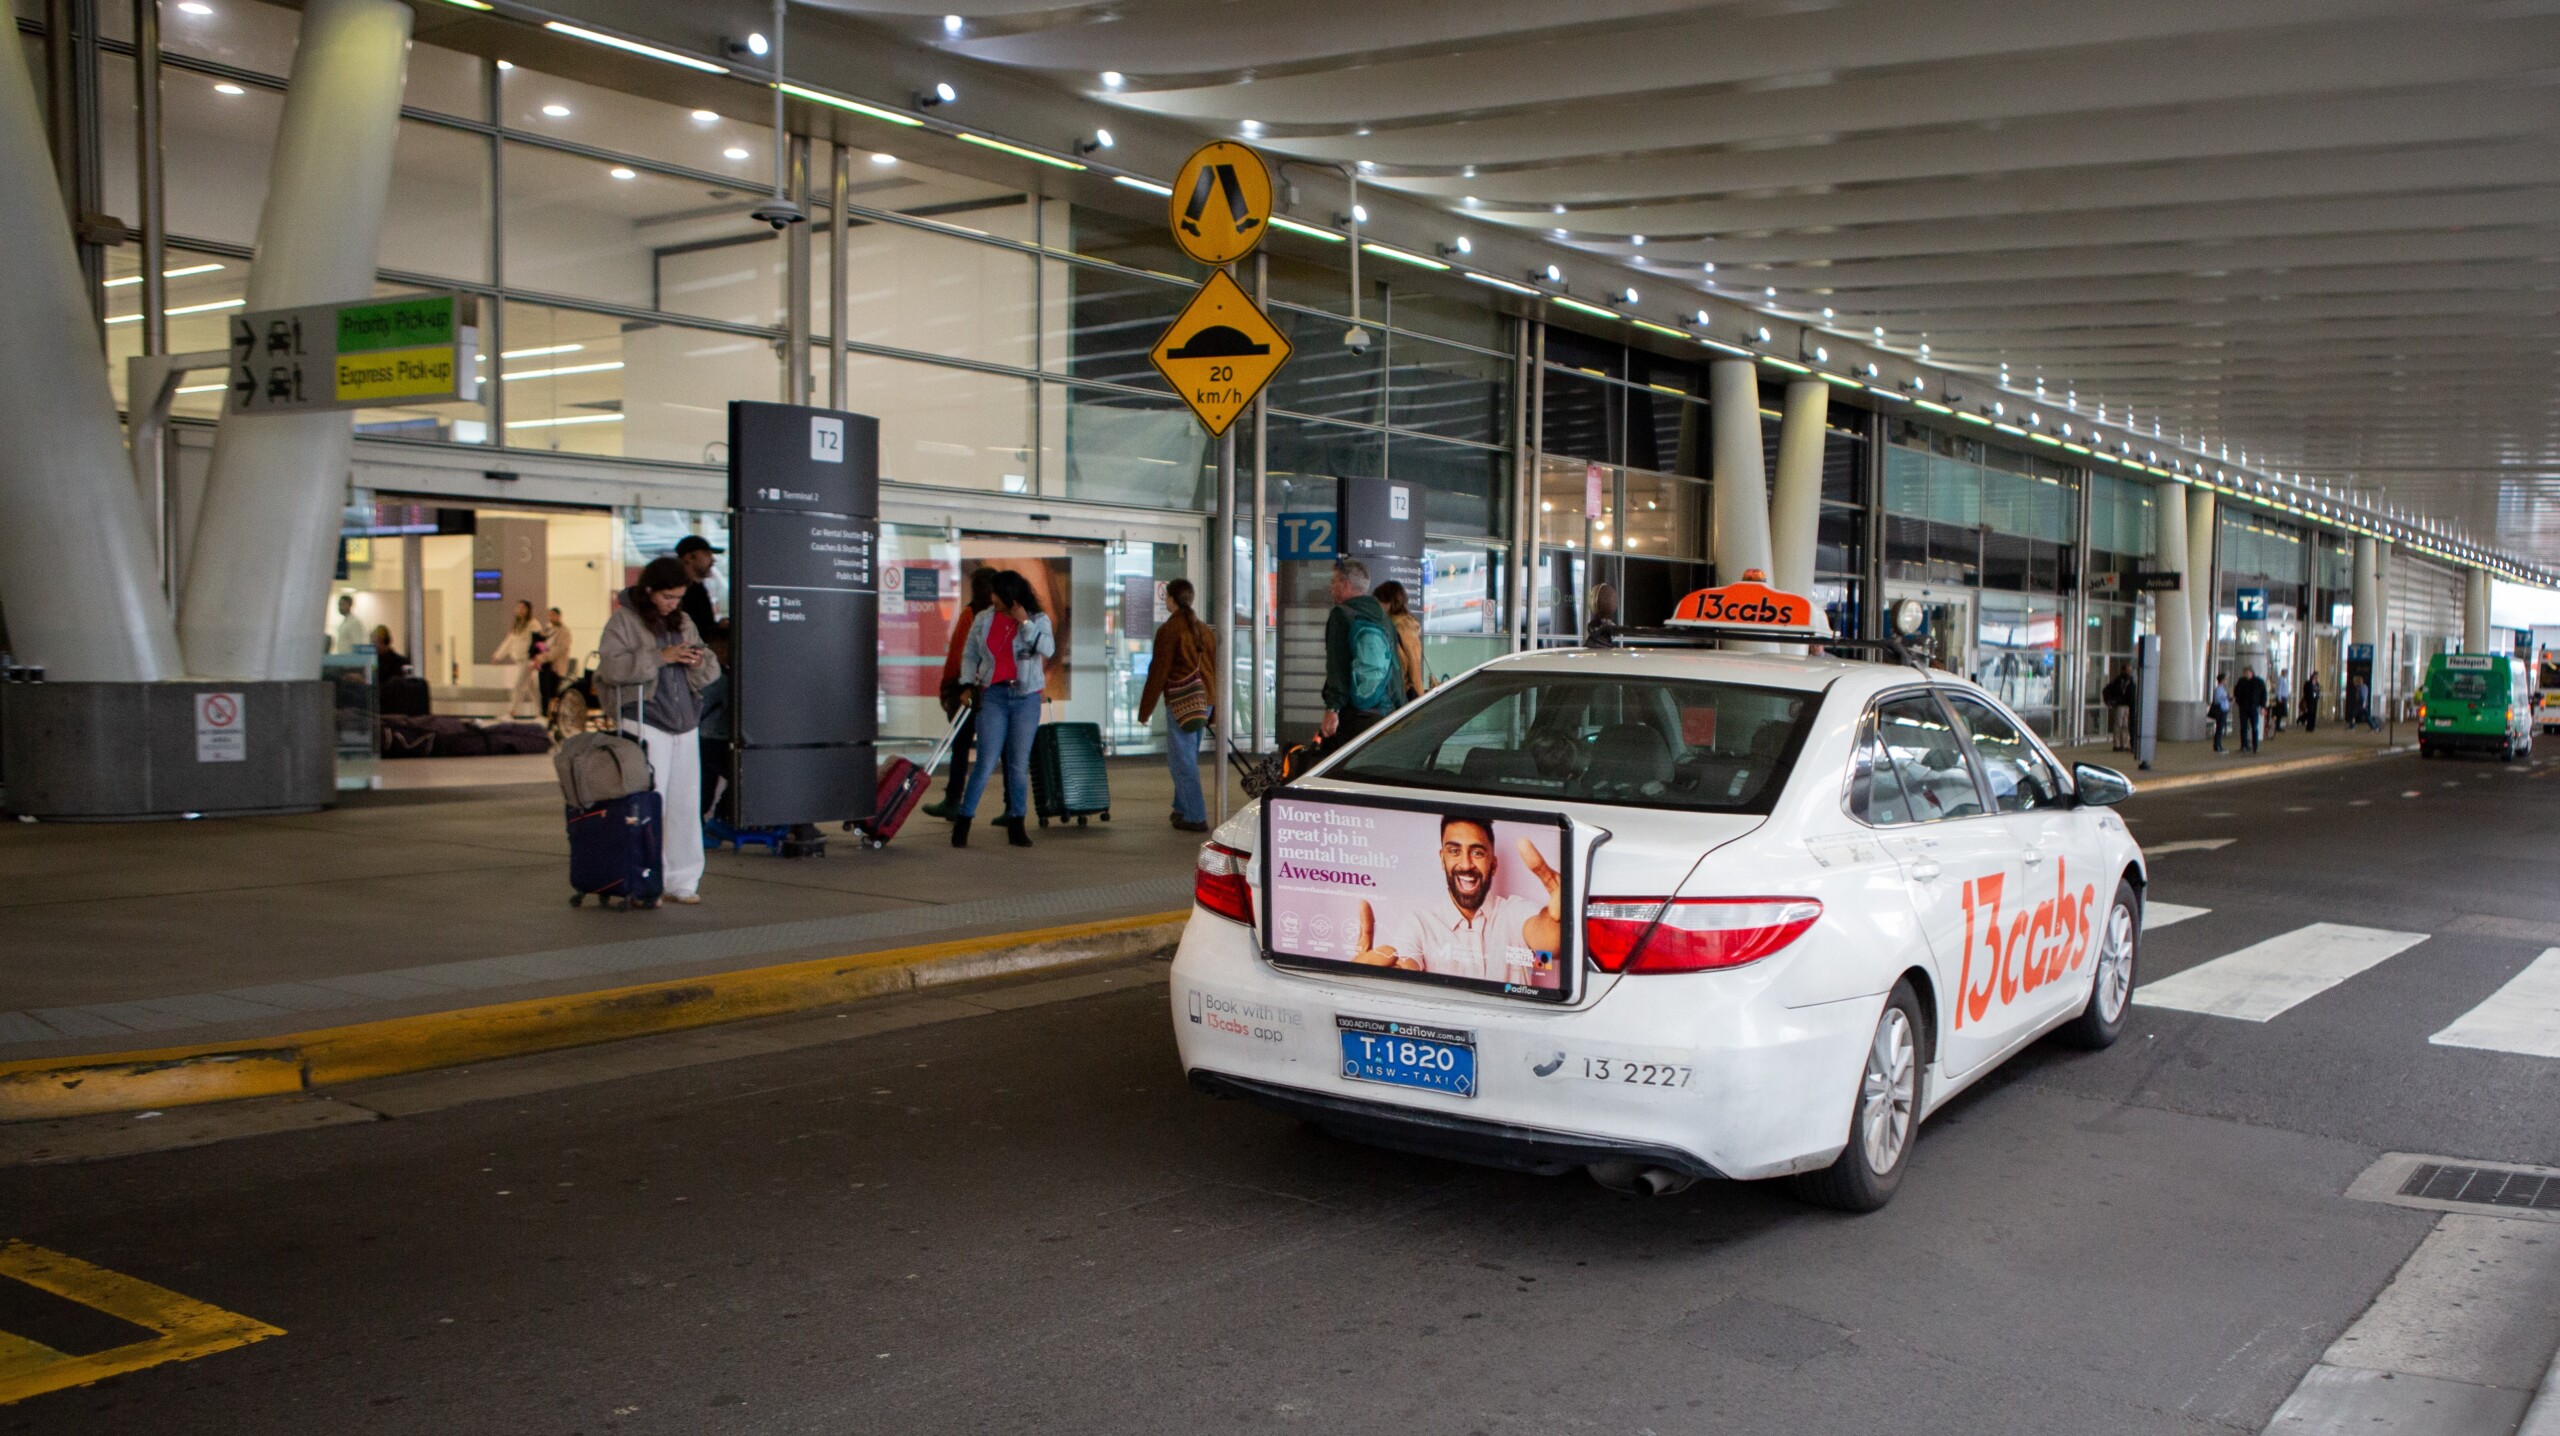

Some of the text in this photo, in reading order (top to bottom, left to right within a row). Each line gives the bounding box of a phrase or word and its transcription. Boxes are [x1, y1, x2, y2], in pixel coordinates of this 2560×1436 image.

[396, 311, 449, 332] Pick-up
[341, 360, 450, 389] Express Pick-up
[1210, 366, 1233, 382] 20
[1197, 388, 1242, 404] km/h
[817, 430, 838, 449] T2
[783, 490, 813, 501] Terminal
[1394, 496, 1406, 511] T2
[1283, 519, 1333, 553] T2
[2146, 578, 2175, 588] Arrivals
[783, 598, 802, 607] Taxis
[1696, 594, 1793, 624] 13cabs
[2239, 596, 2264, 612] T2
[782, 612, 806, 621] Hotels
[2350, 646, 2372, 657] T2
[1277, 805, 1375, 829] More than a
[1277, 827, 1368, 847] great job in
[1278, 847, 1399, 869] mental health?
[1277, 861, 1376, 887] Awesome.
[1954, 854, 2095, 1031] 13cabs
[1206, 994, 1303, 1026] Book with the
[1206, 1012, 1283, 1043] 13cabs app
[1338, 1018, 1385, 1031] 1300 ADFLOW
[1366, 1065, 1396, 1078] NSW
[1583, 1057, 1693, 1088] 13 2227
